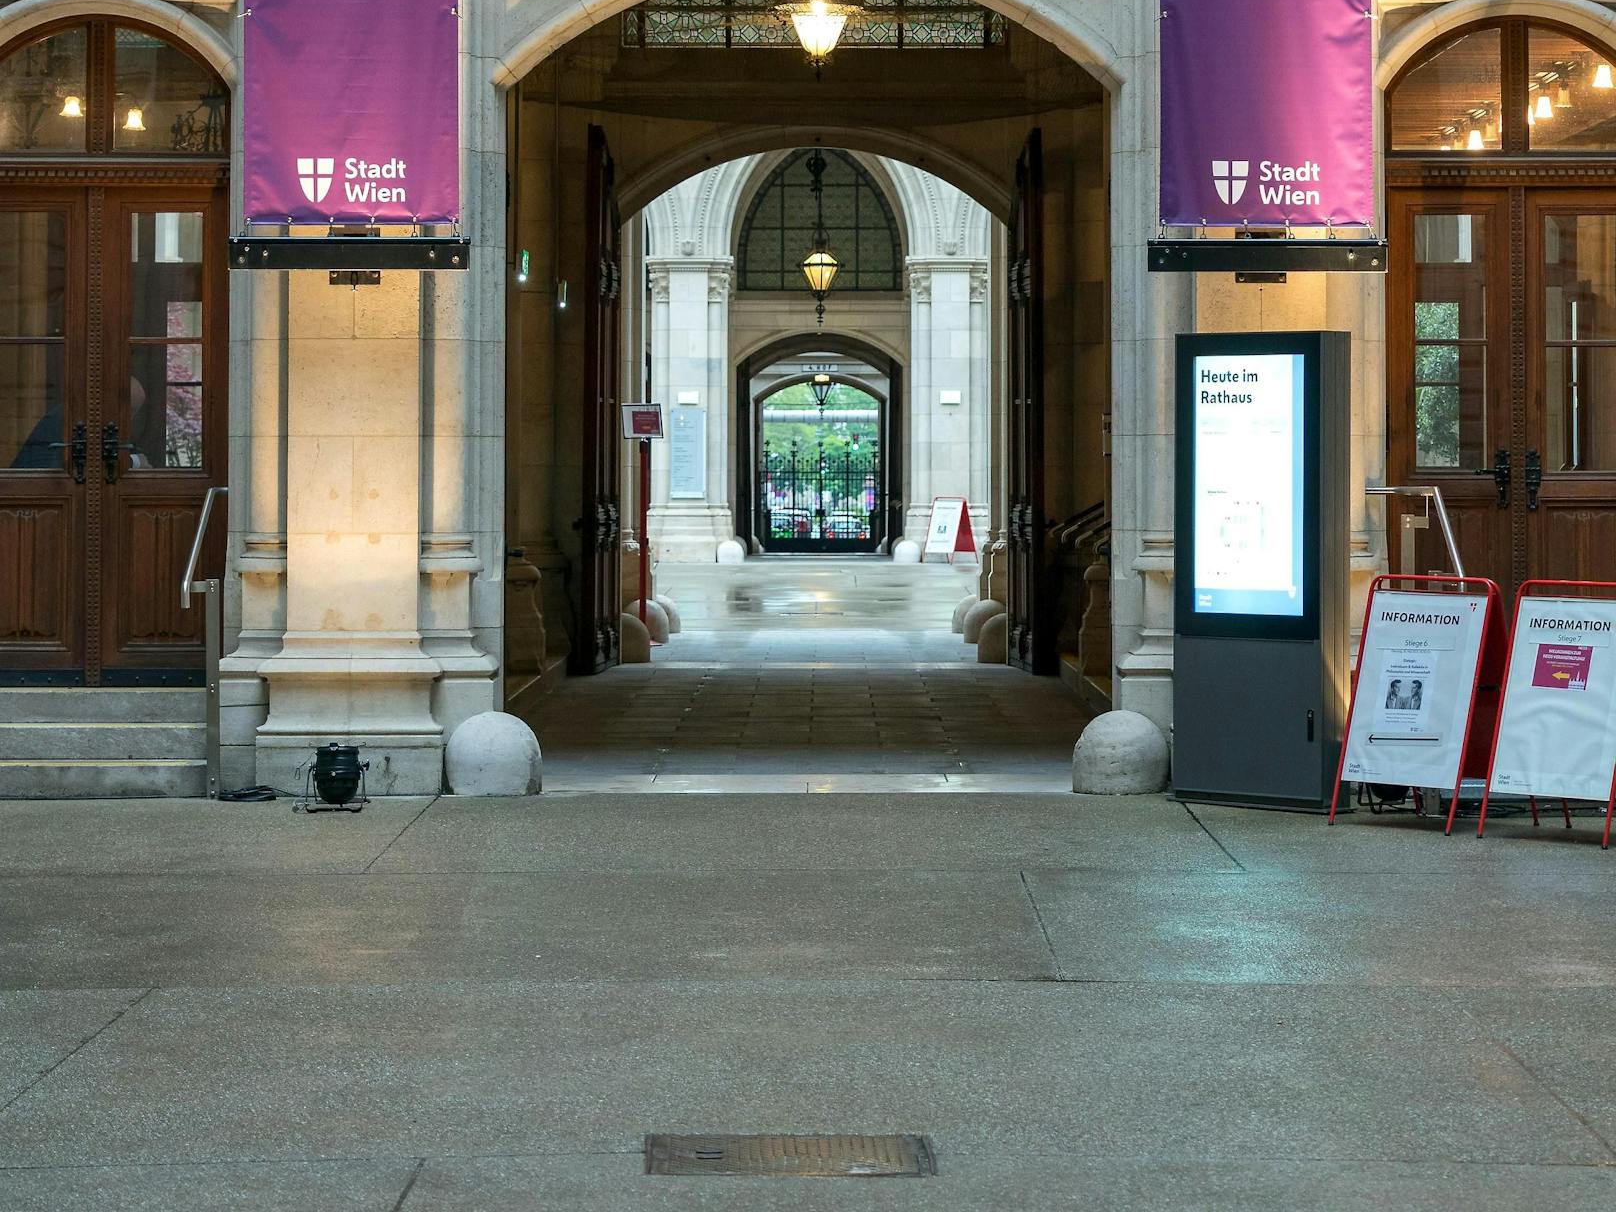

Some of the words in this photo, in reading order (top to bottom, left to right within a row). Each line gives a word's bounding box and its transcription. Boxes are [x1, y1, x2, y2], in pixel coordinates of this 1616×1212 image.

[344, 157, 407, 180] Stadt
[1259, 160, 1321, 182] Stadt
[344, 181, 406, 203] Wien
[1259, 184, 1320, 205] Wien
[1201, 369, 1239, 383] Heute
[1242, 368, 1258, 383] im
[1201, 390, 1252, 404] Rathaus
[1381, 611, 1460, 626] INFORMATION
[1529, 618, 1611, 632] INFORMATION
[1404, 639, 1423, 648] Stiege
[1558, 635, 1577, 643] Stiege
